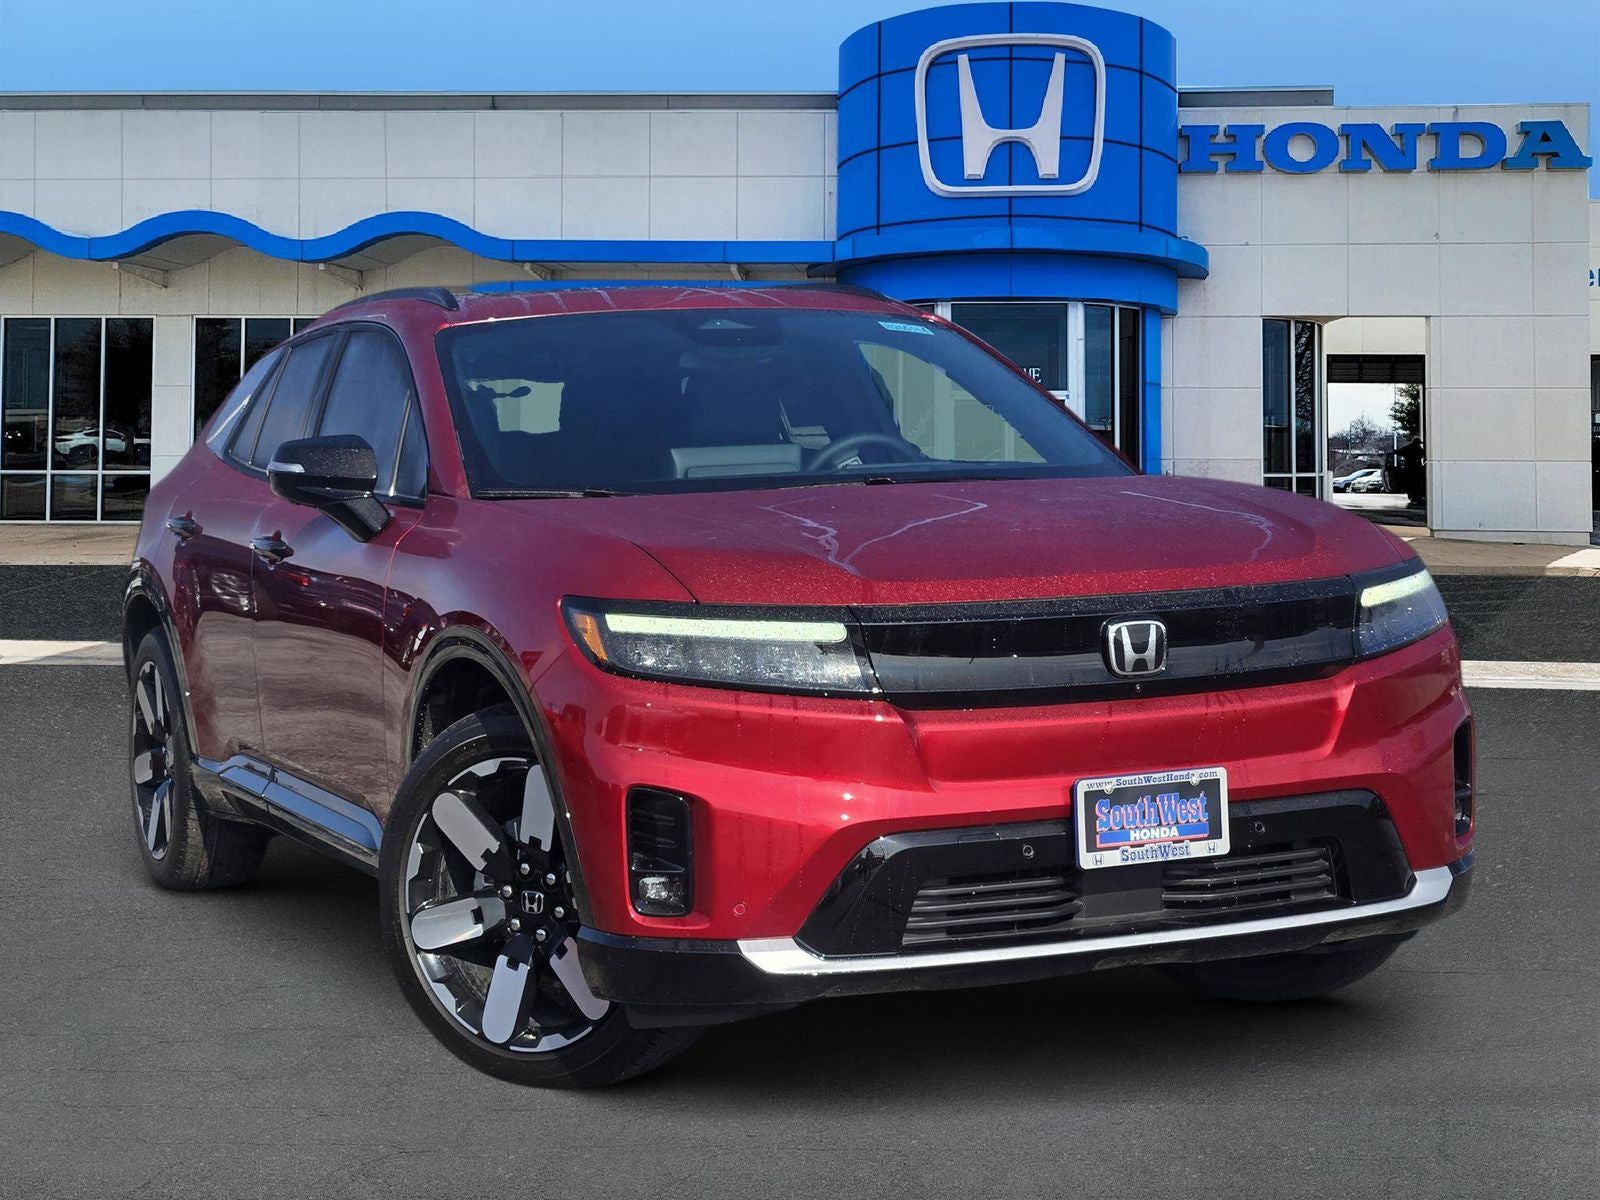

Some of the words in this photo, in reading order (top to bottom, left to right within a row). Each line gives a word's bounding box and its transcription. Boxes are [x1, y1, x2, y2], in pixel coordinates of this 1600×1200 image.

[1178, 120, 1593, 174] HONDA
[1129, 826, 1179, 841] HONDA
[1121, 842, 1190, 862] SouthWest
